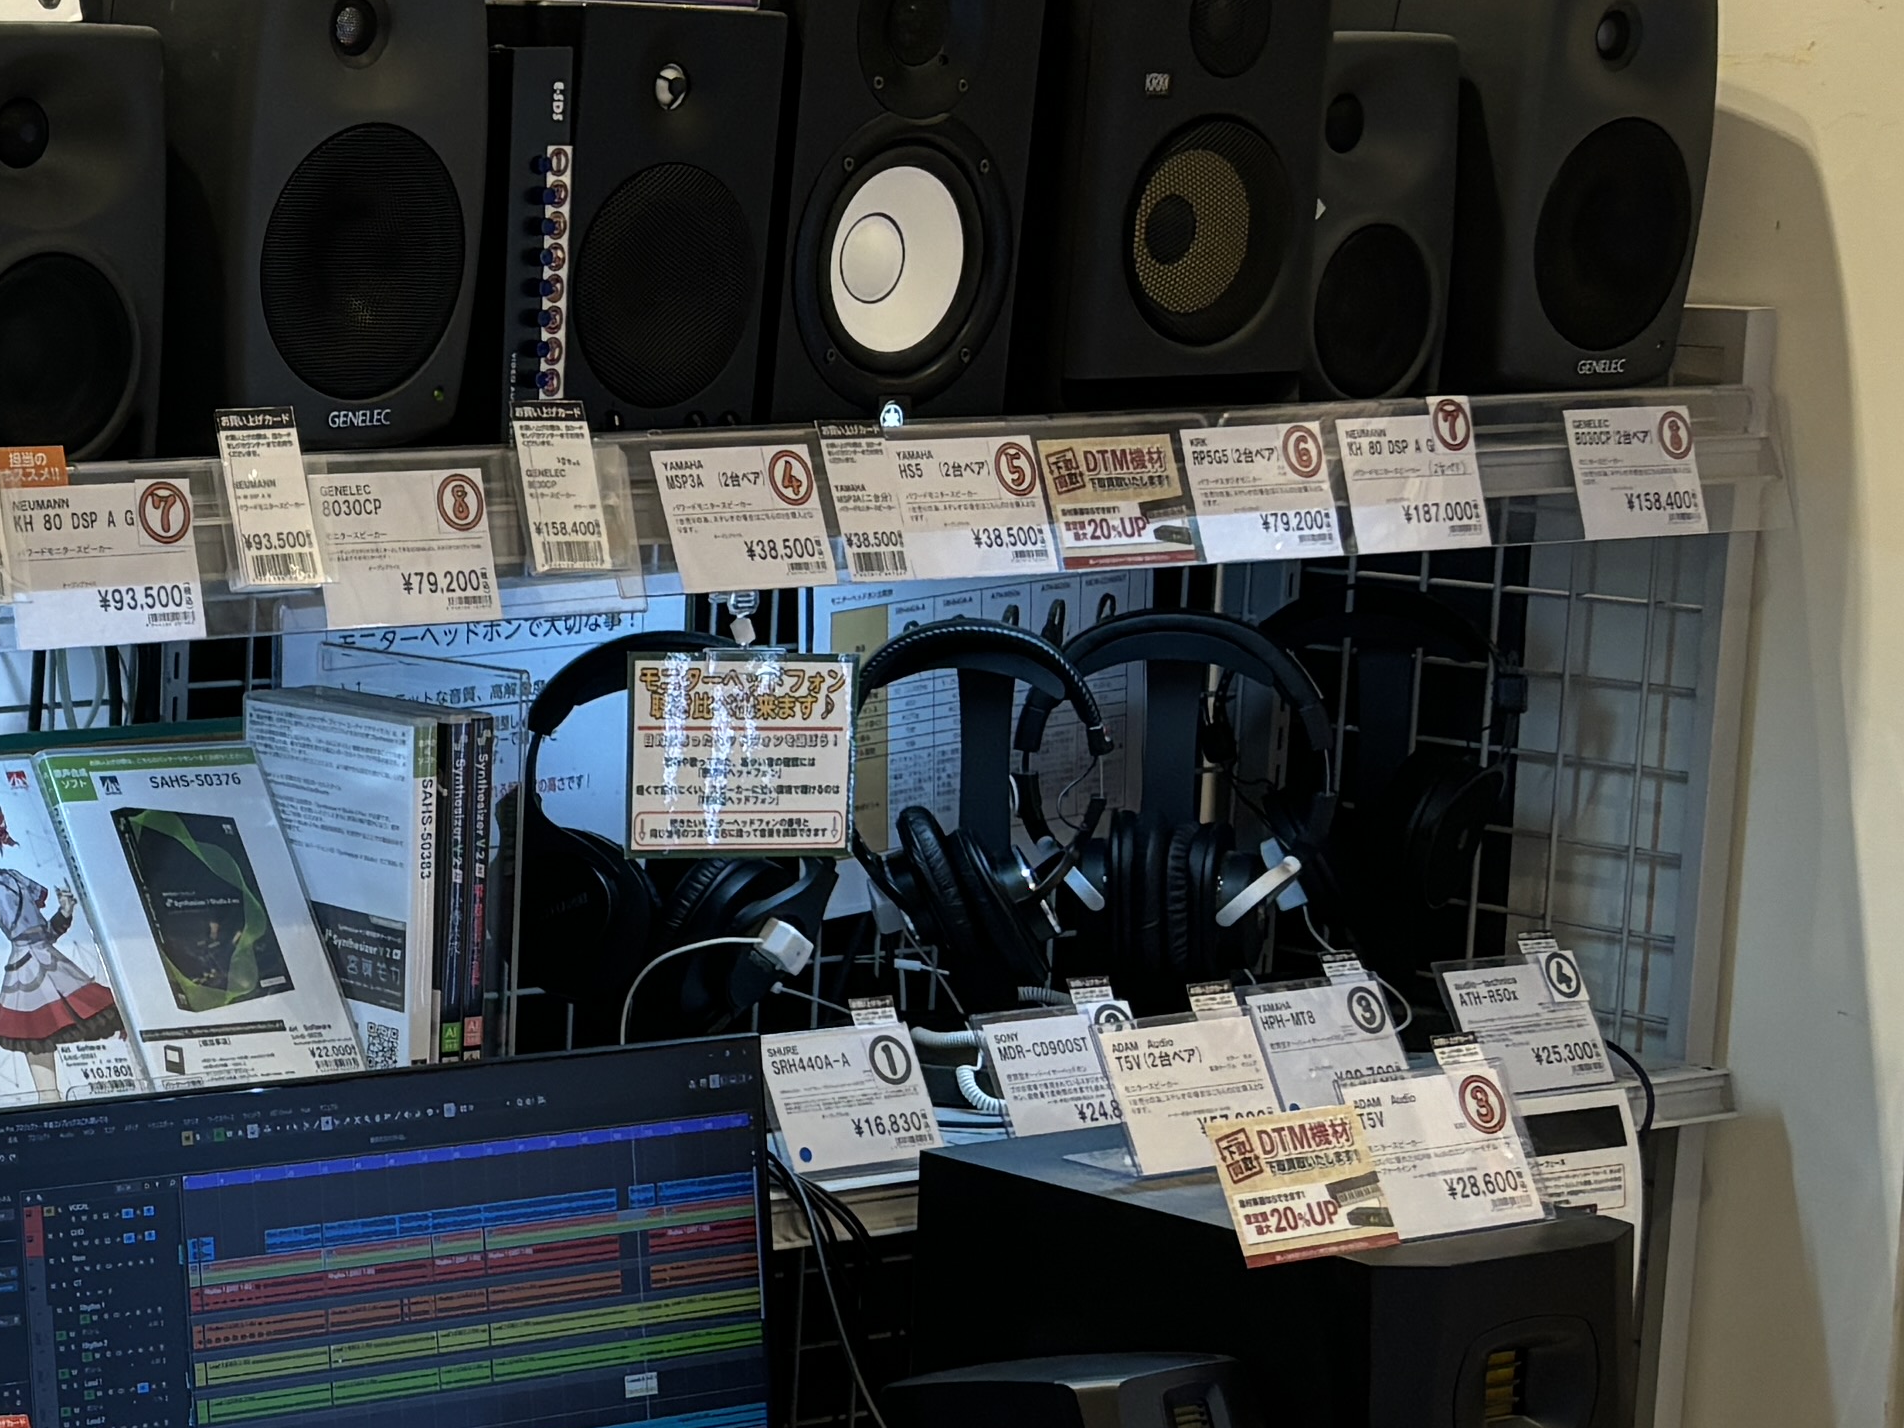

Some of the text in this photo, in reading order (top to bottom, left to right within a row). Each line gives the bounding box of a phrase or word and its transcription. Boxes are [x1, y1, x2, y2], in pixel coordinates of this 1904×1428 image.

[1577, 359, 1626, 375] GENELEC
[328, 410, 392, 429] GENELEC
[319, 484, 373, 498] GENELEC
[1624, 491, 1695, 515] ¥158,400
[12, 496, 71, 513] NEUMANN
[321, 499, 383, 520] 8030CP
[1401, 501, 1475, 526] ¥187,000
[1259, 511, 1325, 534] ¥79,200
[745, 537, 817, 561] ¥38,500
[971, 526, 1039, 548] ¥38,500
[401, 571, 481, 595] ¥79,200
[98, 586, 184, 612] ¥93,500
[148, 772, 242, 790] SAHS-50376
[766, 1045, 800, 1059] SHURE
[997, 1037, 1090, 1063] MDR-CD900ST
[1530, 1041, 1593, 1066] ¥25,300
[770, 1052, 852, 1076] SRH440A-A
[851, 1111, 922, 1138] ¥16,830
[1258, 1118, 1353, 1157] DTM機材
[1443, 1169, 1519, 1201] ¥28,600
